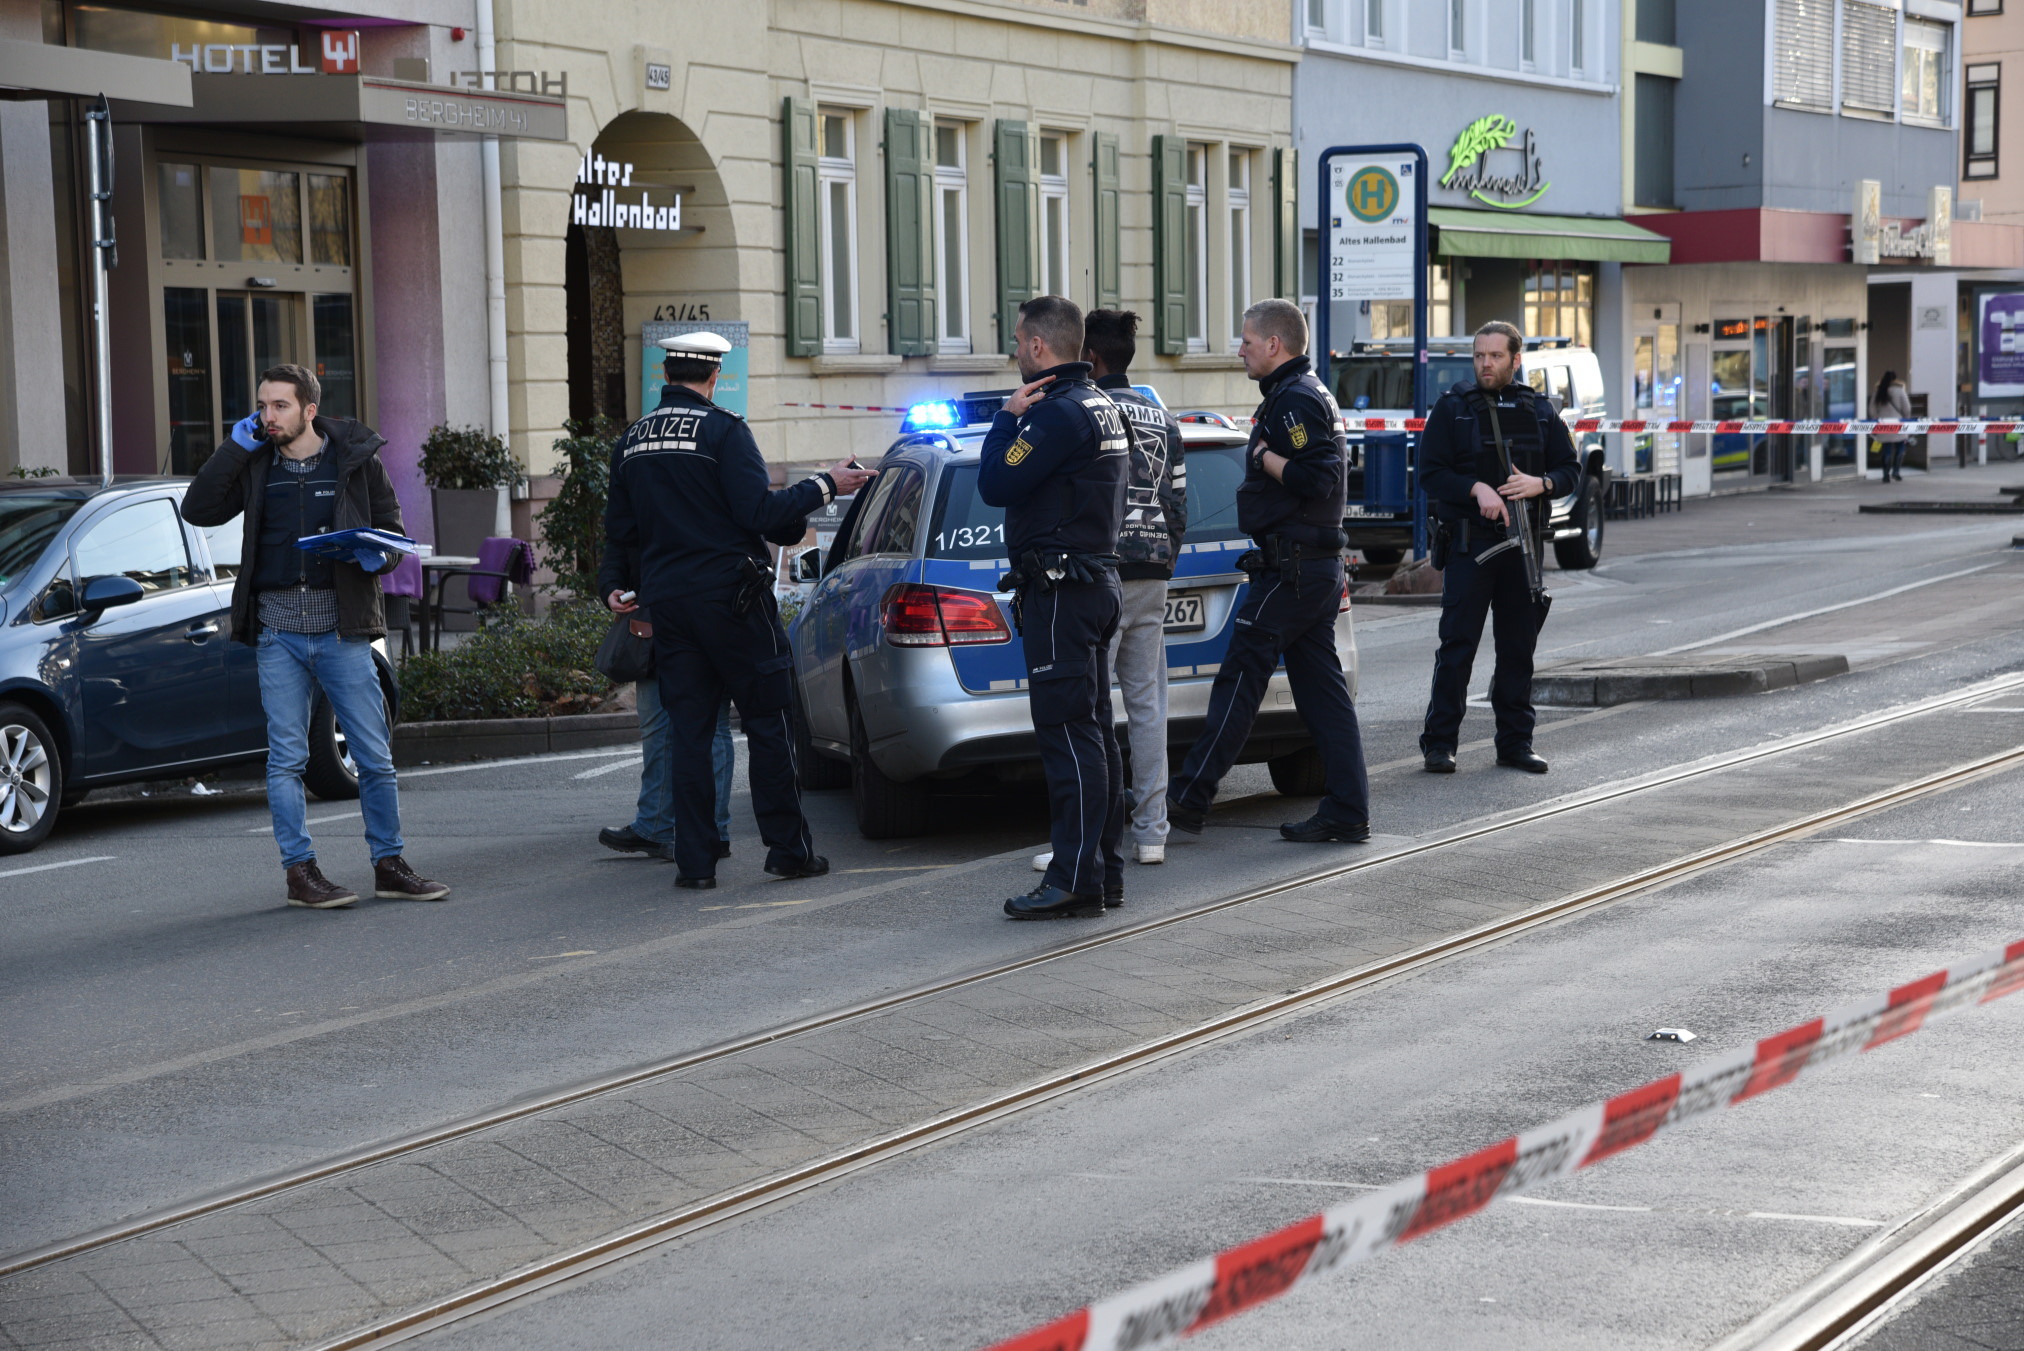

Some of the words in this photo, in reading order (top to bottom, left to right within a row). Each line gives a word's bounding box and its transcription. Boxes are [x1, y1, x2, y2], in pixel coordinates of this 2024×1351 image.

[172, 43, 315, 73] HOTEL
[649, 69, 669, 85] 43/45
[406, 99, 506, 129] BERGHEIM
[510, 110, 528, 132] 41
[1361, 179, 1385, 210] H
[574, 189, 681, 231] Hallenbad
[1339, 238, 1361, 246] Altes
[1363, 235, 1407, 246] Hallenbad
[1332, 256, 1344, 266] 22
[1332, 272, 1344, 282] 32
[1332, 288, 1344, 298] 35
[654, 304, 710, 322] 43/45
[626, 416, 701, 446] POLIZEI
[935, 523, 1005, 551] 1/321
